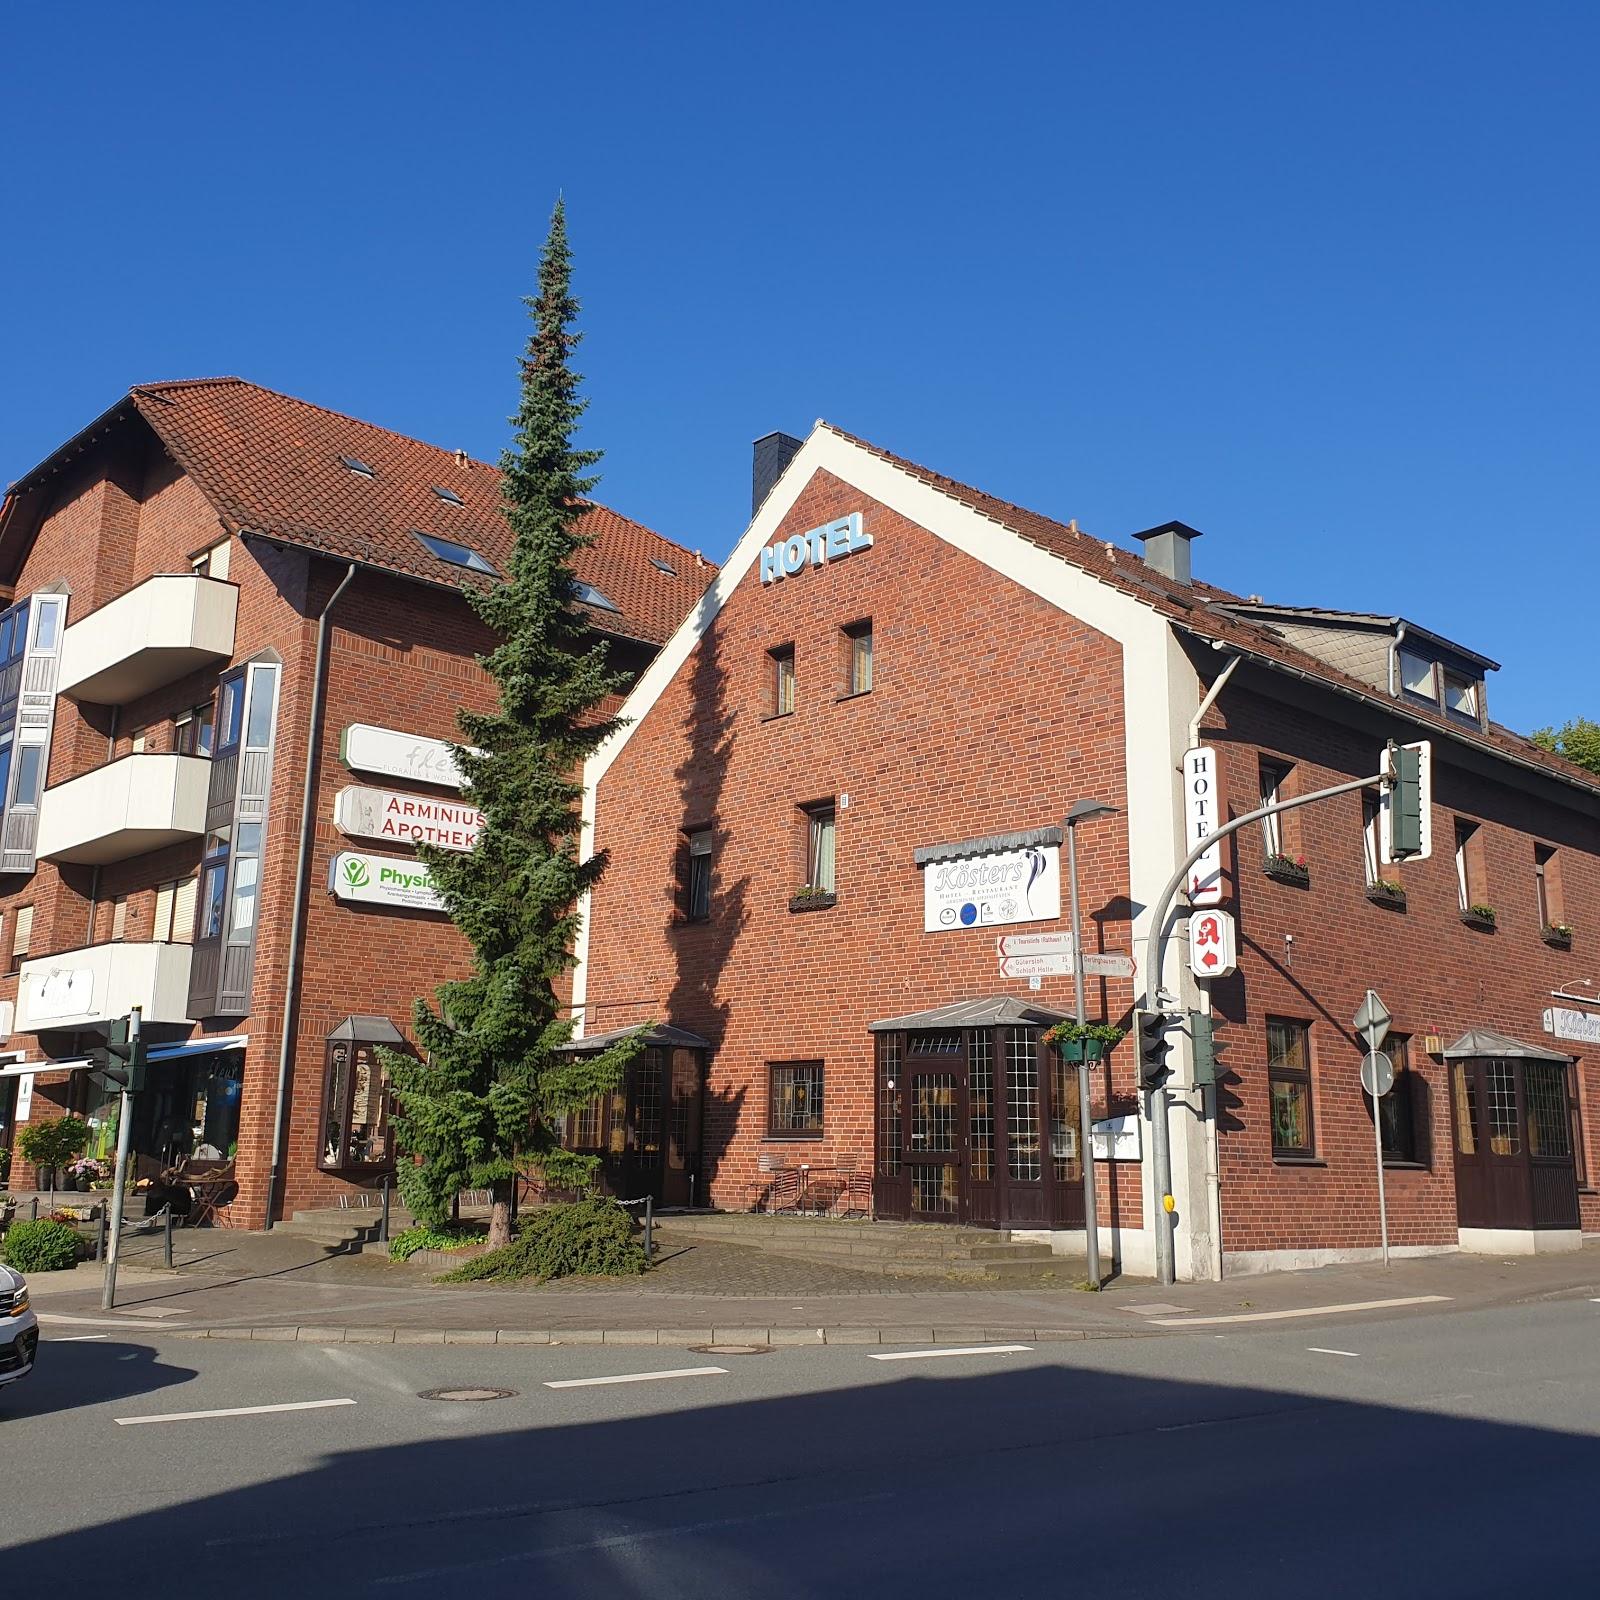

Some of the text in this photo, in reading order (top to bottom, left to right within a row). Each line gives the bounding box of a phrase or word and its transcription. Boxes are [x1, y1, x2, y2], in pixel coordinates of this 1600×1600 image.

[760, 511, 874, 587] HOTEL
[406, 745, 456, 772] fle
[386, 797, 486, 828] ARMINIUS
[1193, 756, 1211, 861] HOTEL
[381, 818, 477, 847] APOTHEK
[380, 867, 440, 889] Physio
[935, 862, 1023, 892] Kösters
